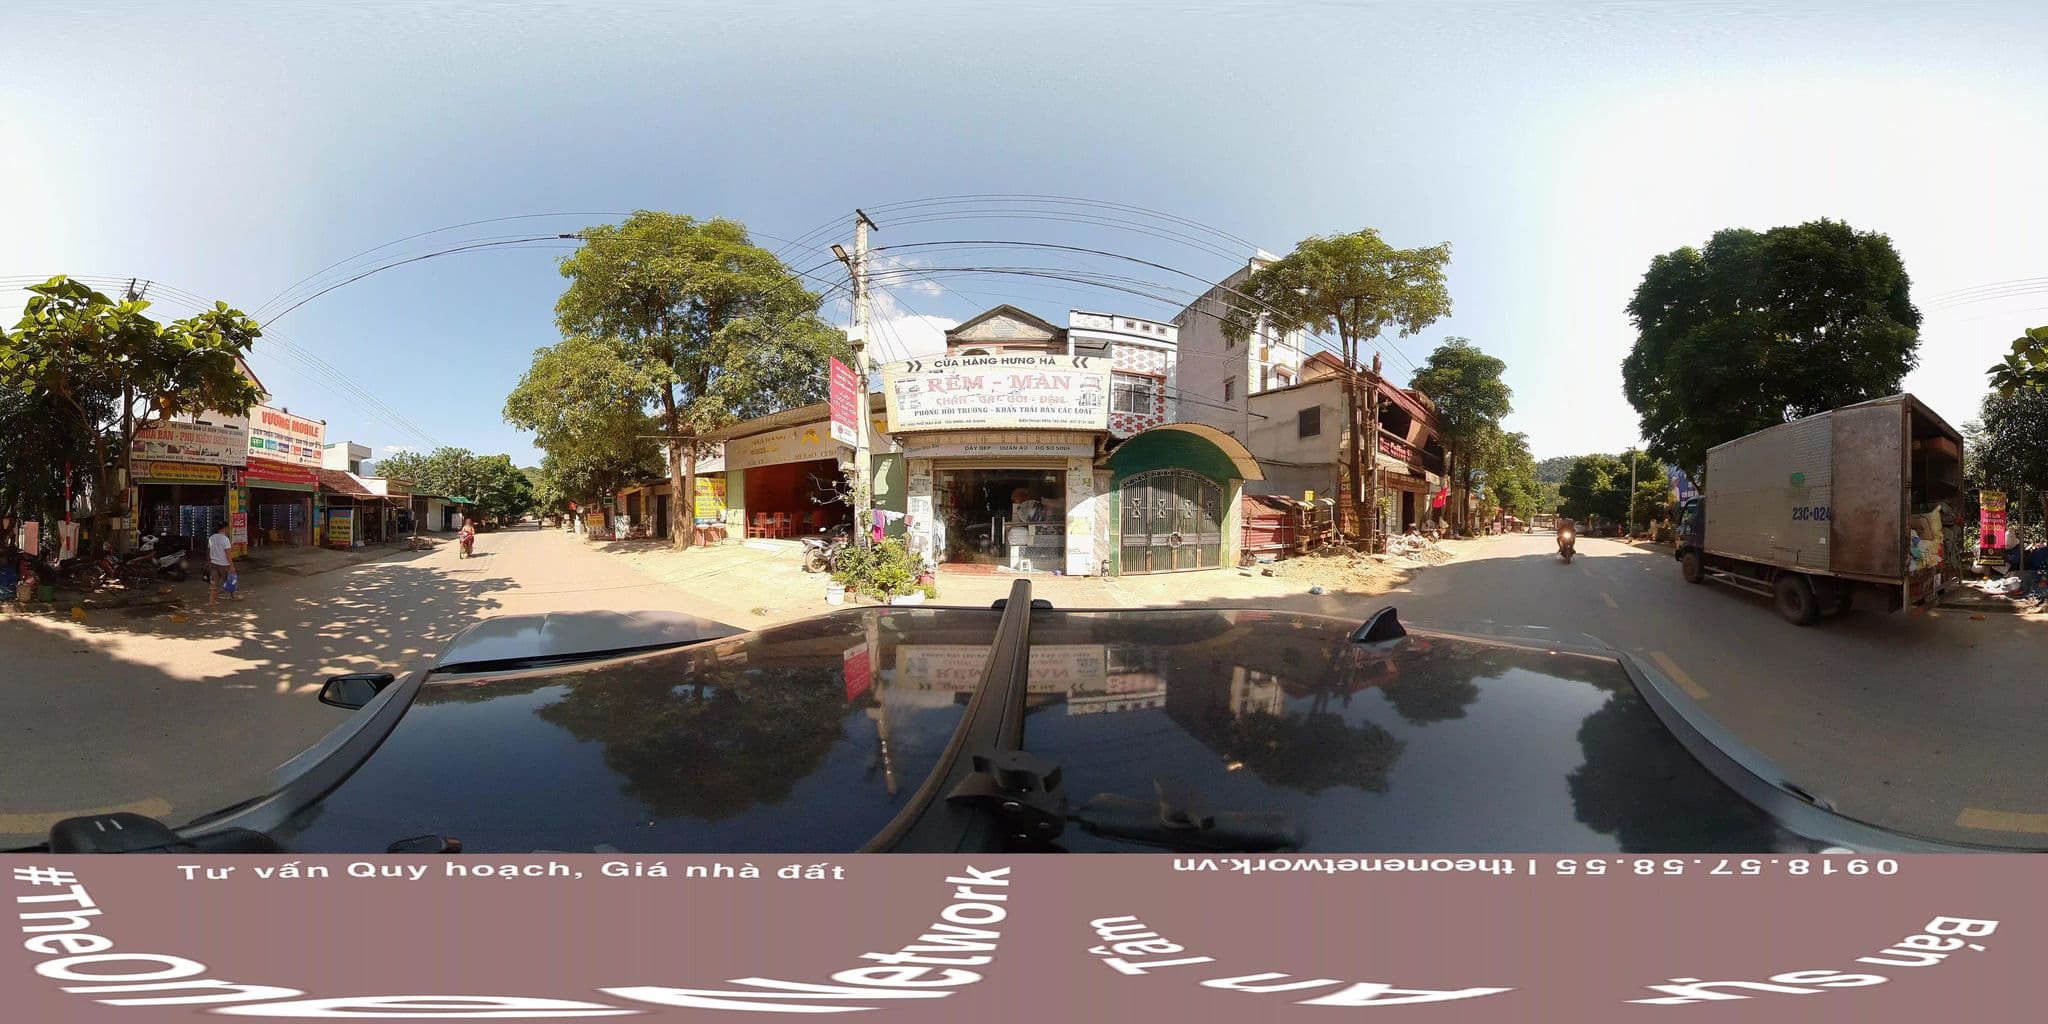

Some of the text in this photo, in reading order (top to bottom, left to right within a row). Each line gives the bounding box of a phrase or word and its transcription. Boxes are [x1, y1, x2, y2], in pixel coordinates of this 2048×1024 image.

[963, 356, 998, 366] HÀNG
[1001, 356, 1036, 365] HƯNG
[262, 411, 320, 437] VƯƠNG MOBILE
